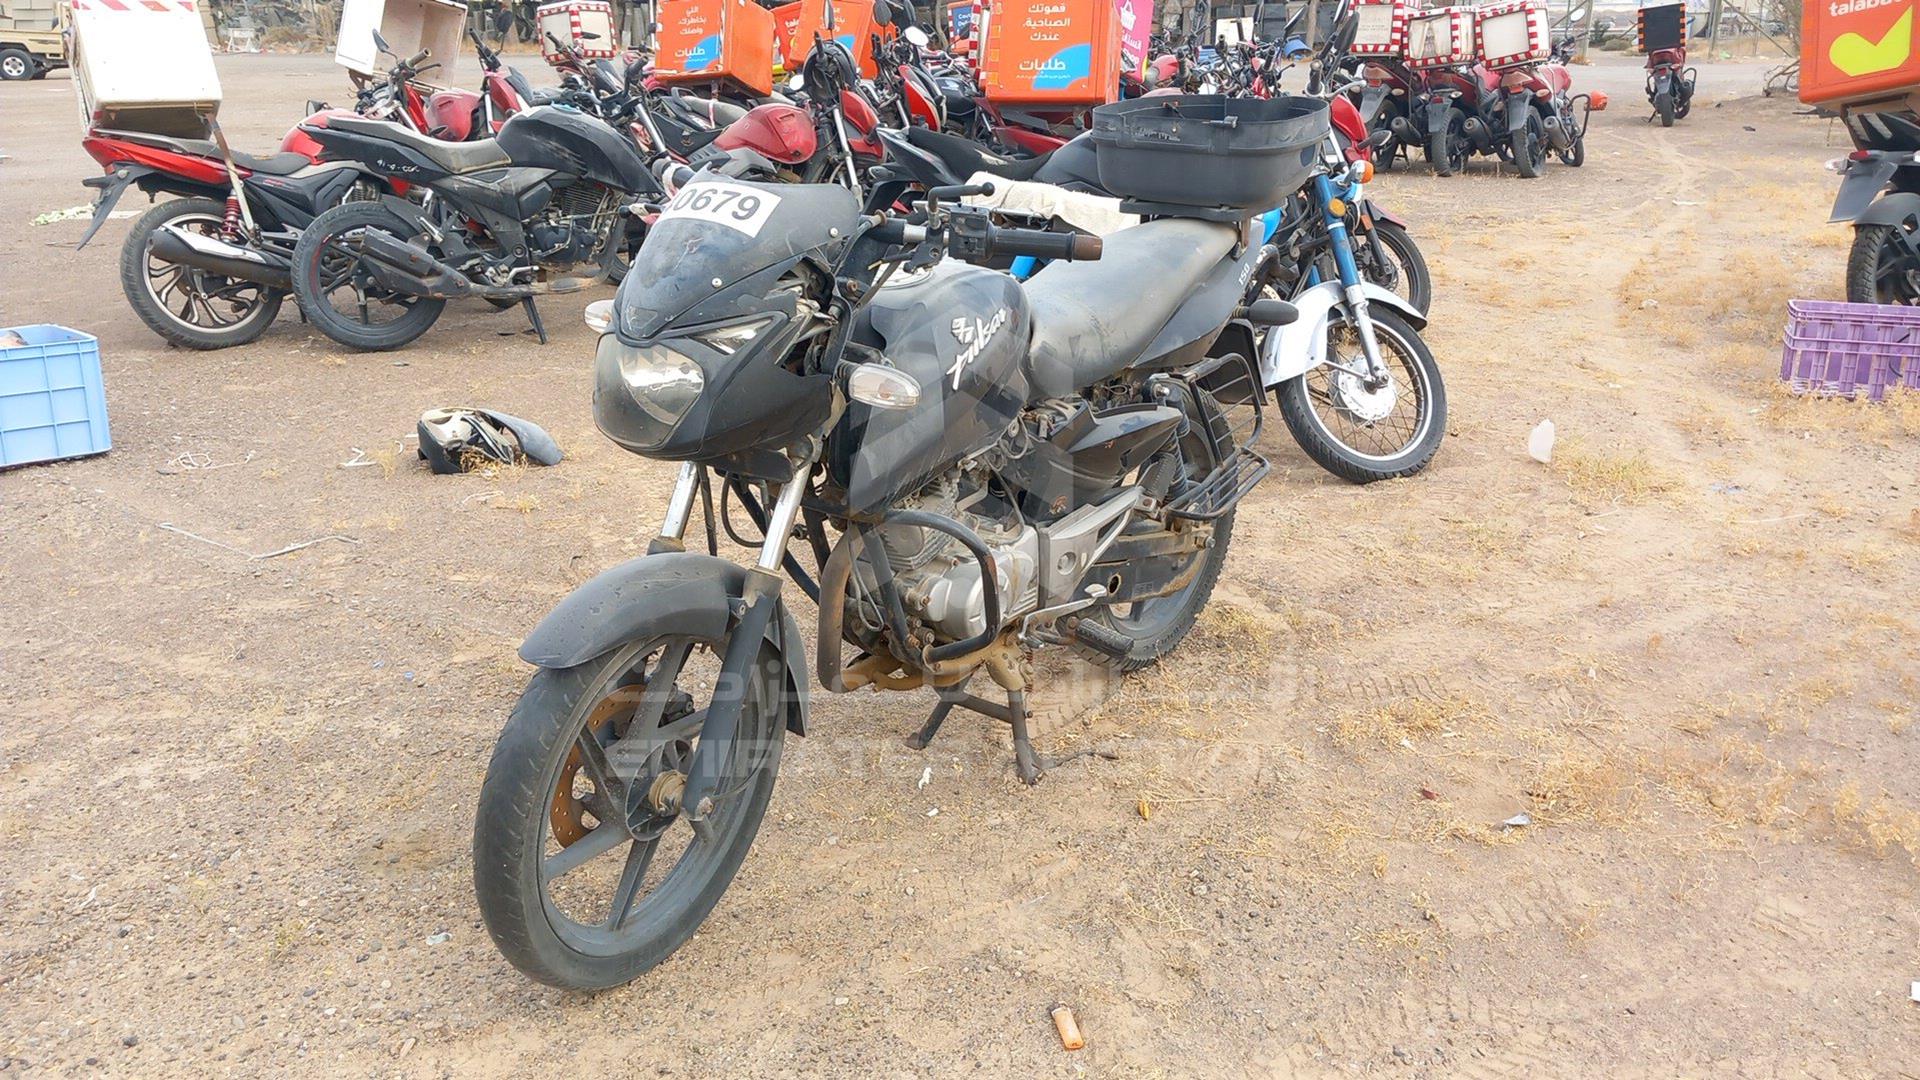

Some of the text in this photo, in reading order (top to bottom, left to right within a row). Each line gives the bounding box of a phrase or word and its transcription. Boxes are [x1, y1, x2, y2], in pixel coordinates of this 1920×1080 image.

[1028, 3, 1066, 15] قهوتك
[1828, 0, 1901, 17] talab
[1030, 32, 1060, 41] عندك
[674, 46, 706, 59] طلبات
[1019, 58, 1066, 75] طلبات
[1238, 262, 1251, 286] 150
